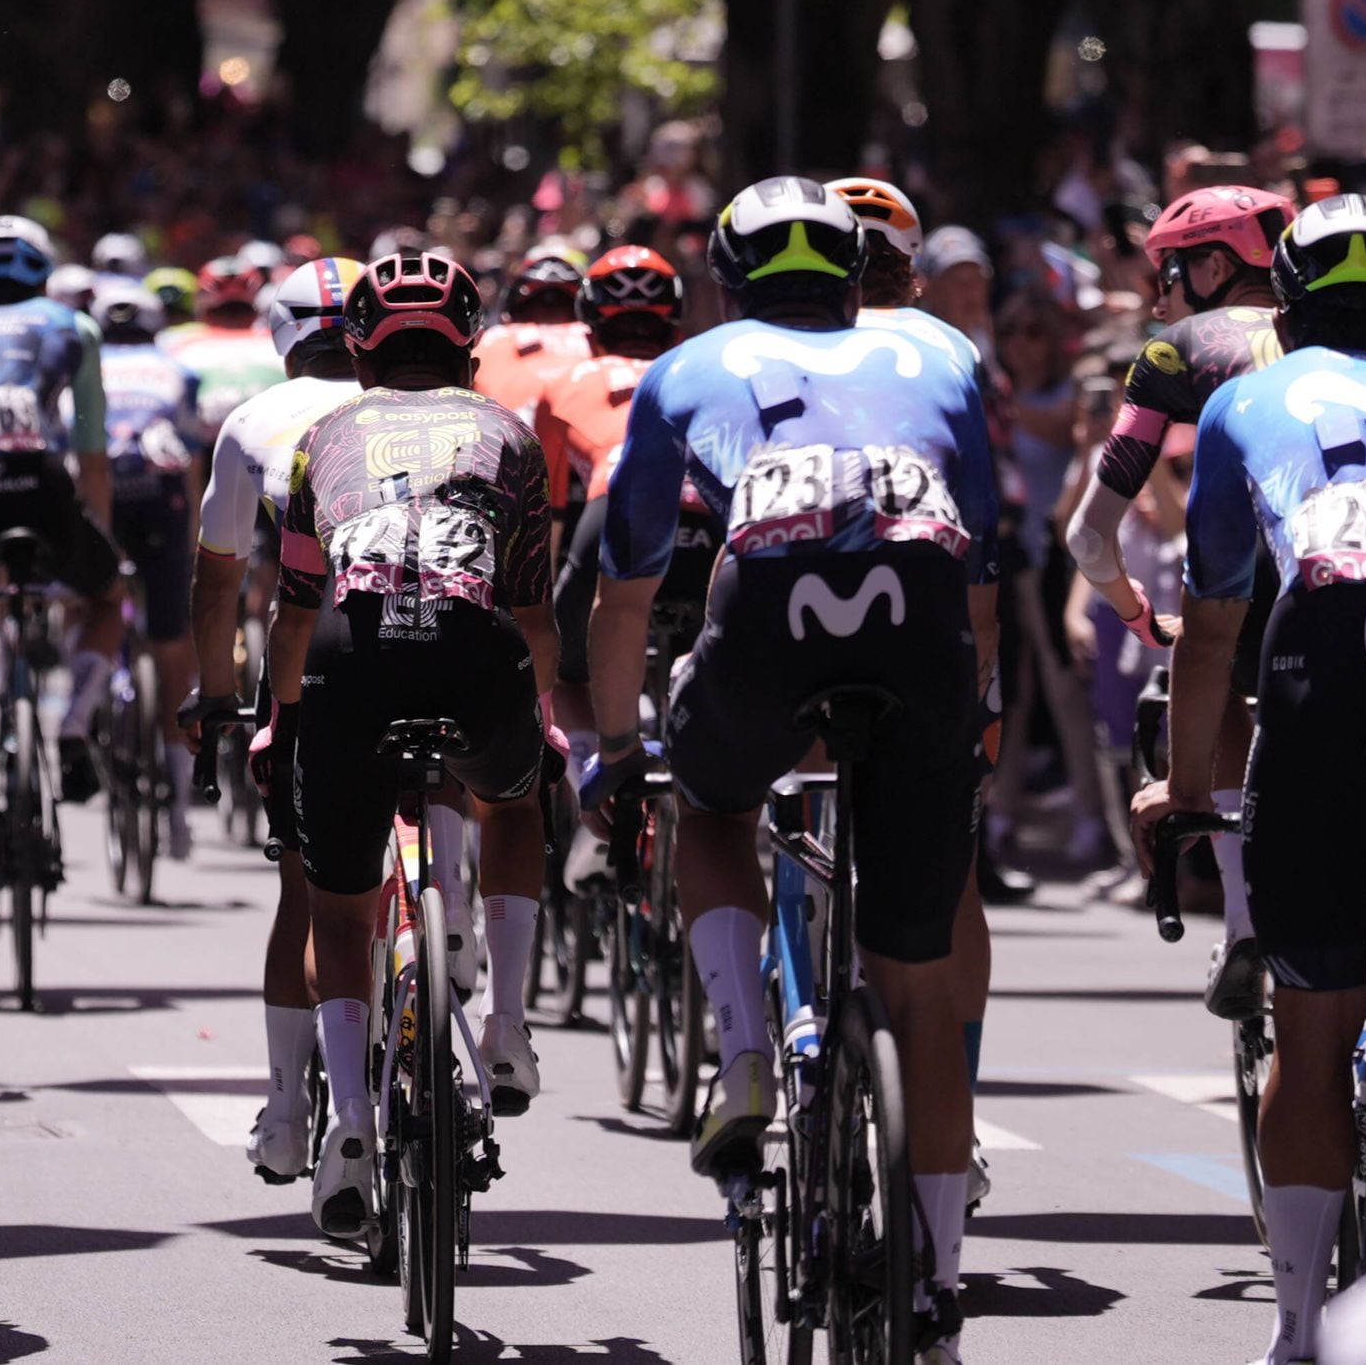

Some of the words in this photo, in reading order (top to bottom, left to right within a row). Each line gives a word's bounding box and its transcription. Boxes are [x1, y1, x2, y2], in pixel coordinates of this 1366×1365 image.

[385, 410, 477, 424] easypost
[742, 454, 828, 523] 123
[675, 525, 713, 549] EA
[378, 626, 437, 642] Education
